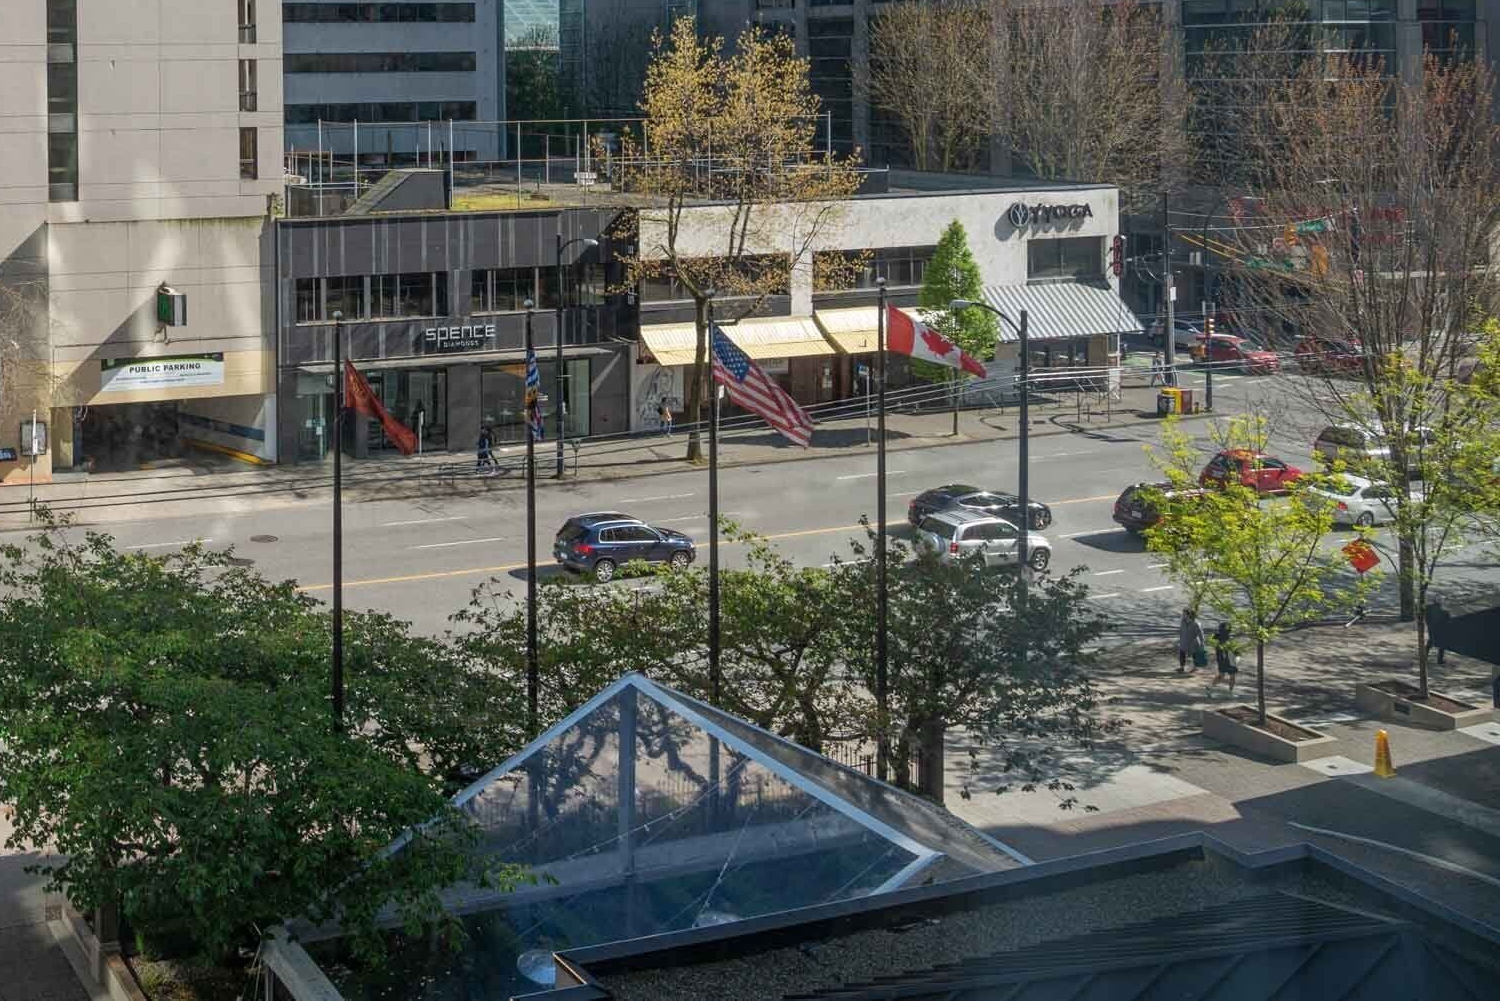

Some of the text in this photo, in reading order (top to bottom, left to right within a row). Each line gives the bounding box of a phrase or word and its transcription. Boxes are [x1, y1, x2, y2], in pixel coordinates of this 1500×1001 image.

[1029, 203, 1093, 223] YYOGA
[425, 325, 496, 348] SPENCE
[129, 362, 202, 373] PUBLIC PARKING
